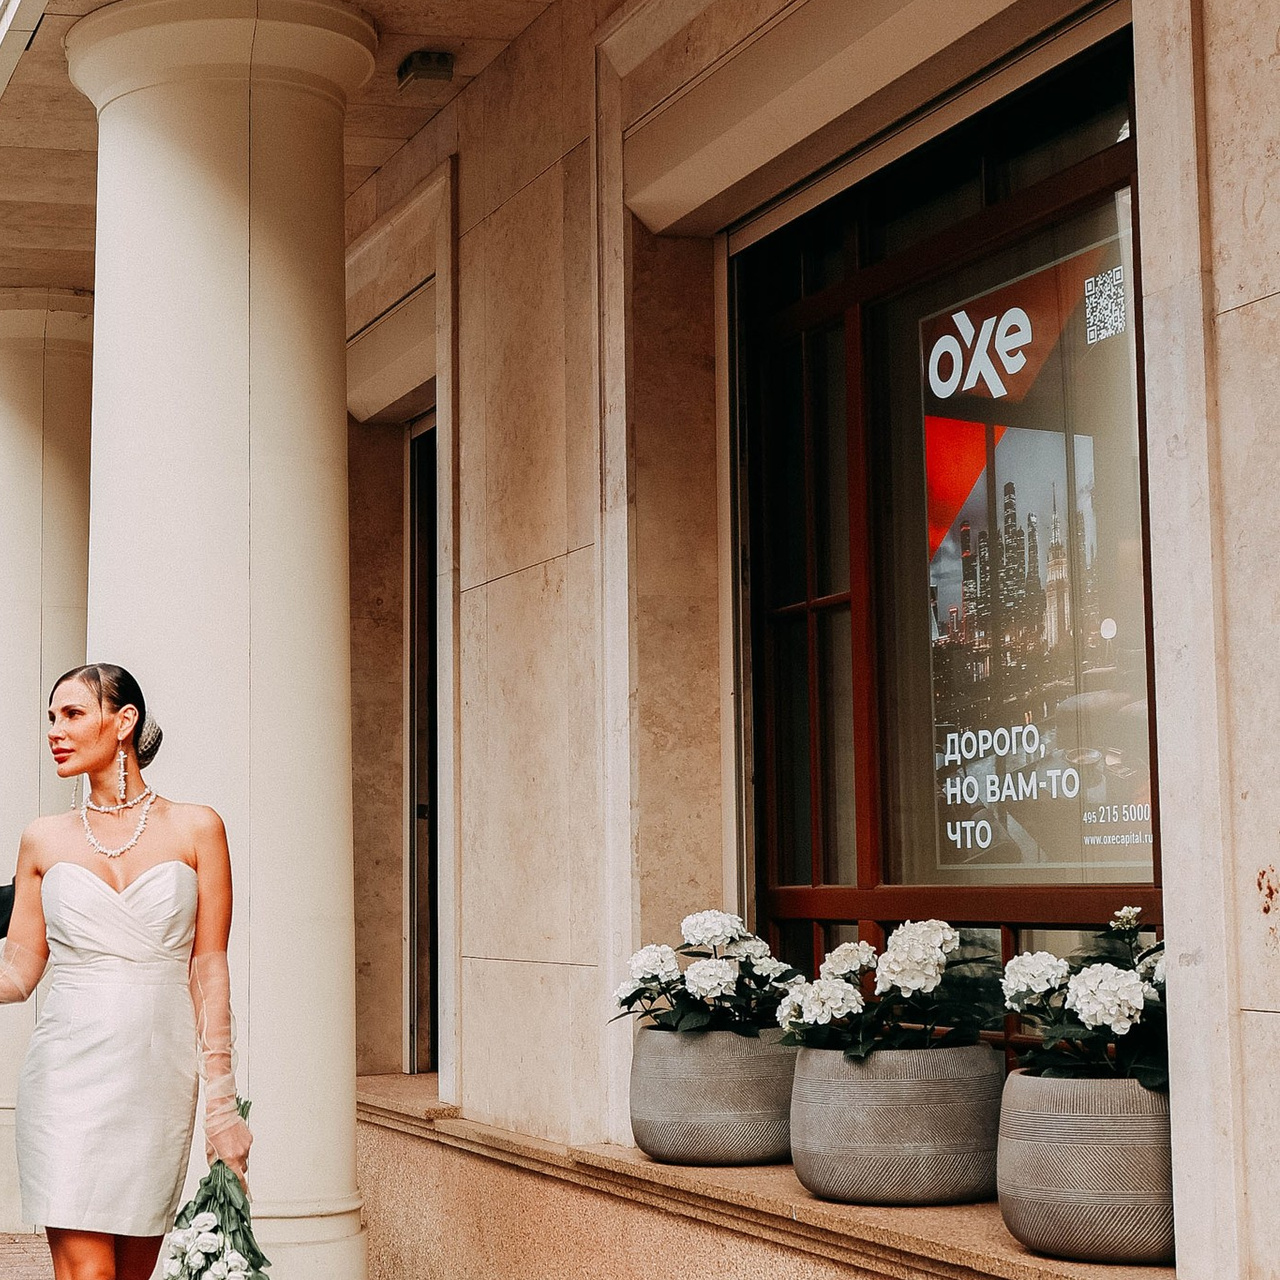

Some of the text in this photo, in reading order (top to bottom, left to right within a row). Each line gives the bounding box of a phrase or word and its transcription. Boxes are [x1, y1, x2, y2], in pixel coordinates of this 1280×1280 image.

[944, 724, 1045, 766] ДОРОГО,
[946, 768, 1080, 805] НО ВАМ-ТО
[1082, 803, 1150, 823] 495 215 5000
[946, 820, 992, 848] ЧТО
[1083, 831, 1153, 847] www.oxecapital.ru
